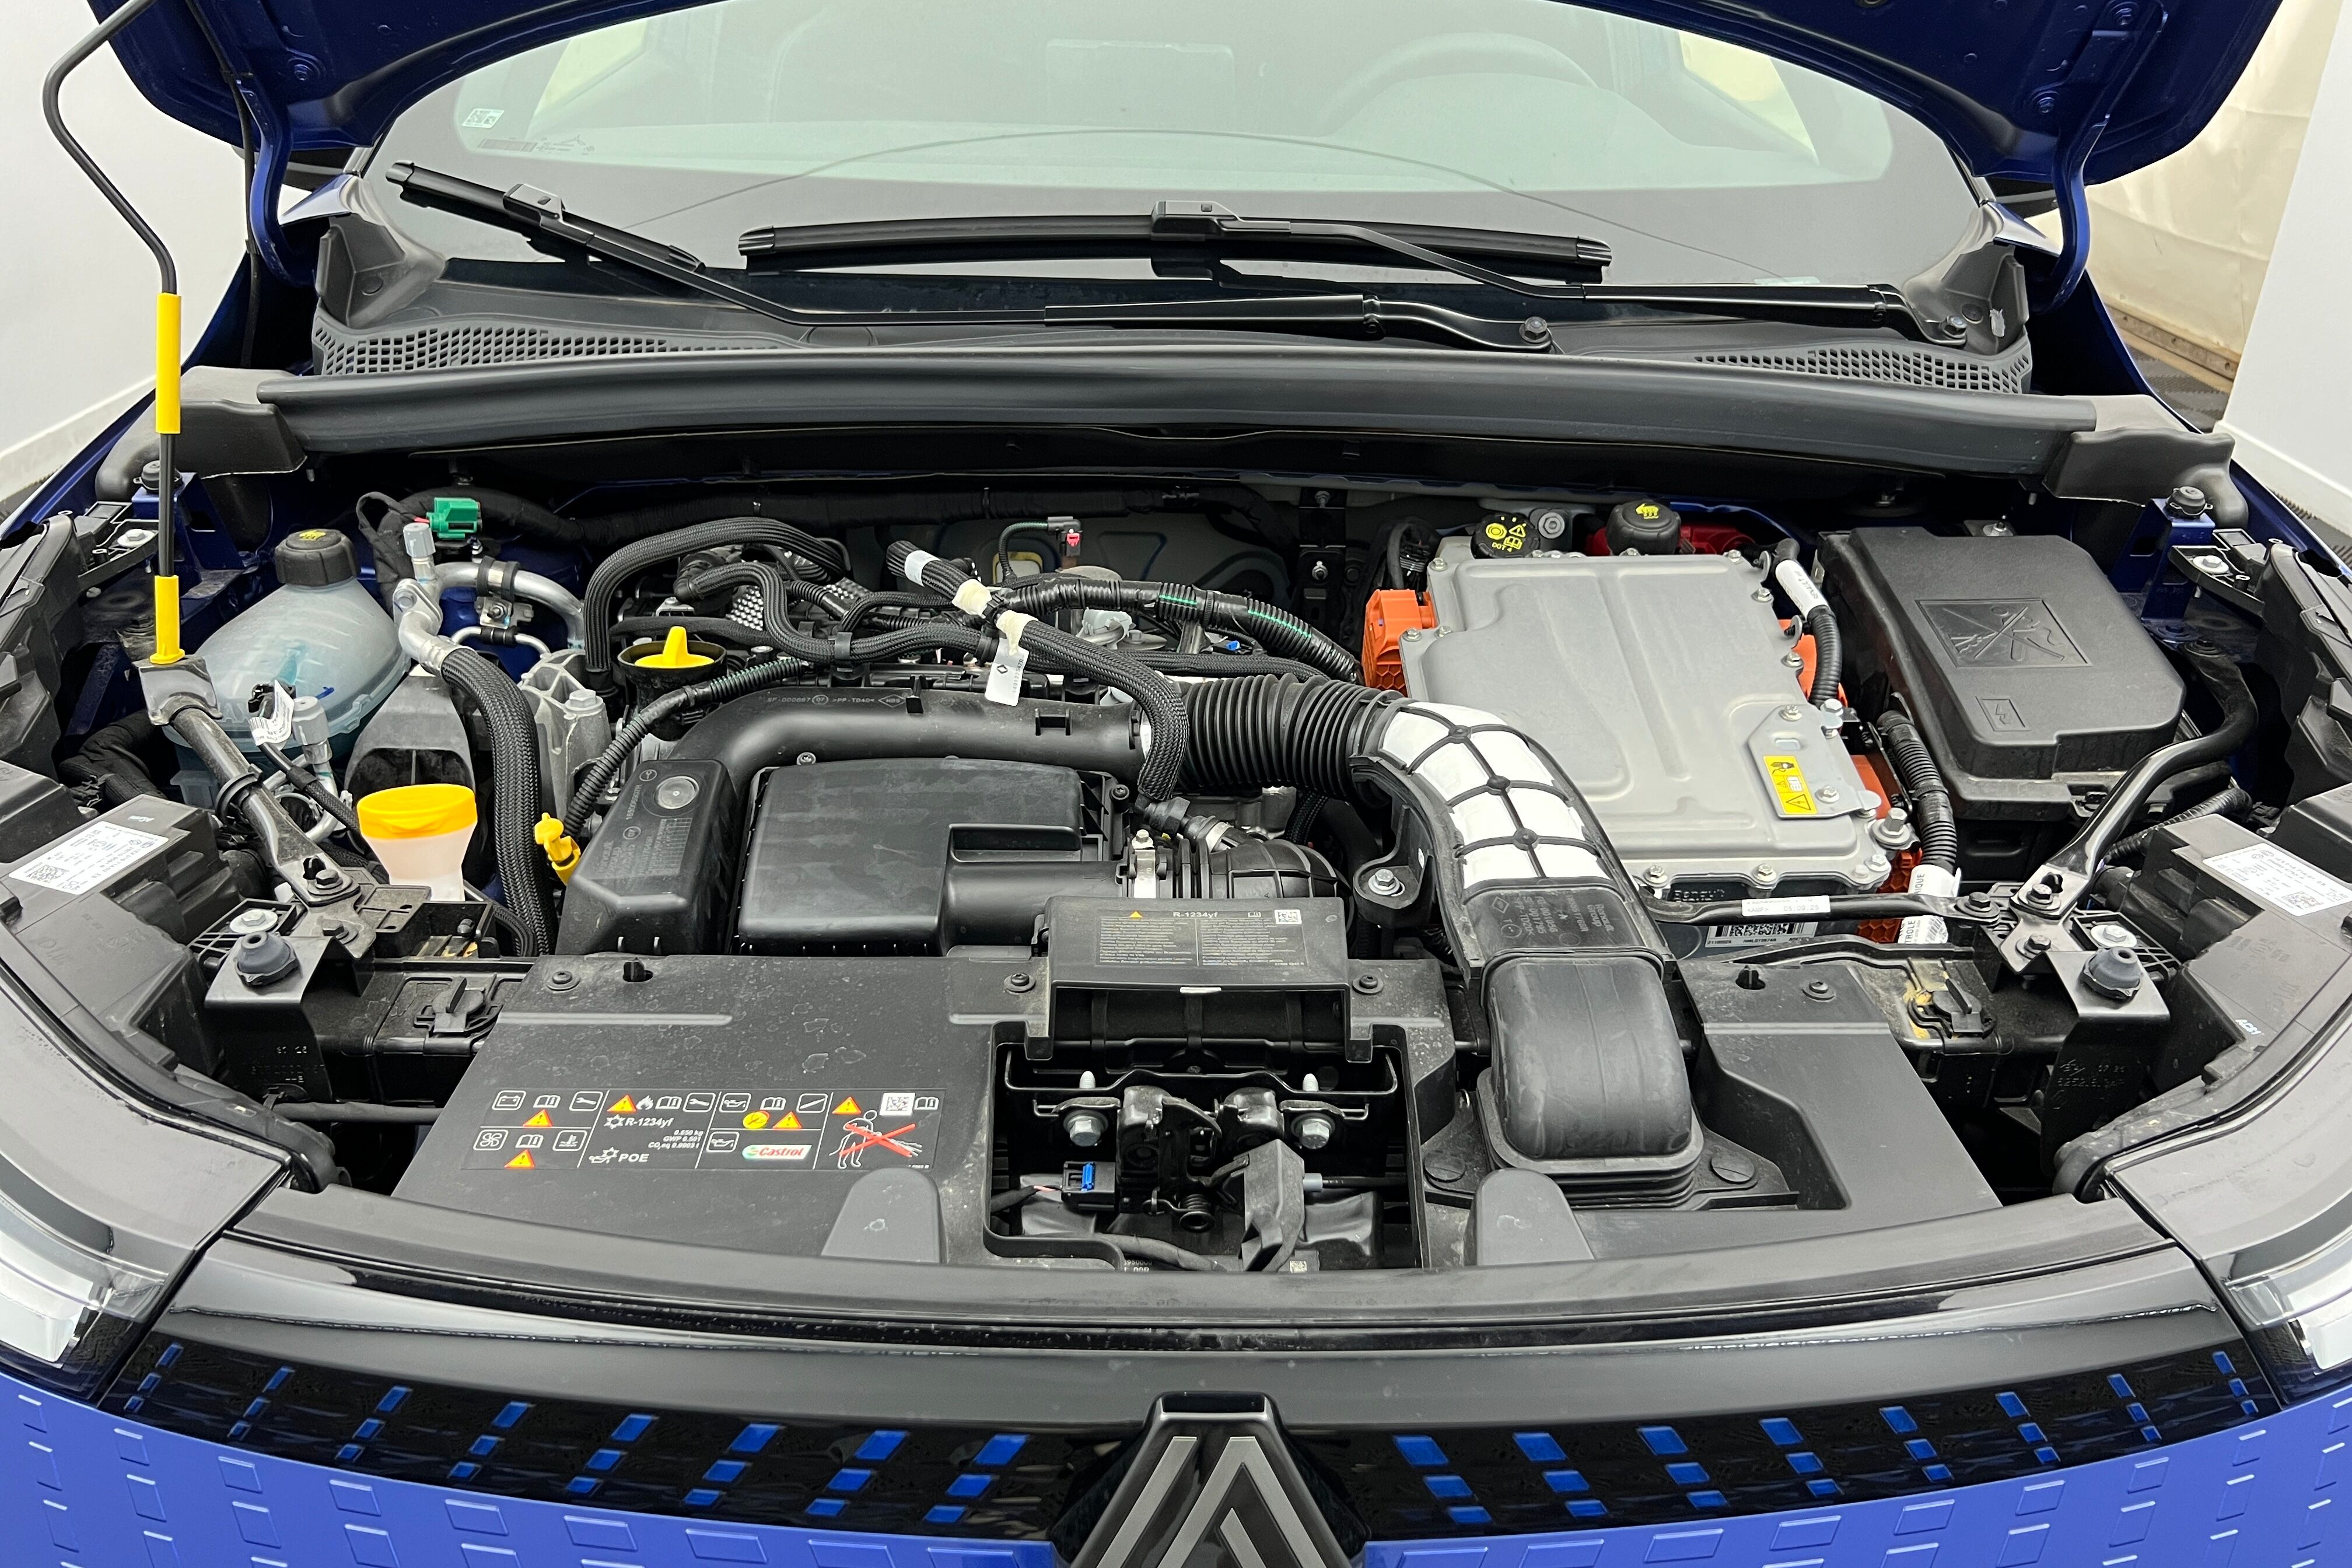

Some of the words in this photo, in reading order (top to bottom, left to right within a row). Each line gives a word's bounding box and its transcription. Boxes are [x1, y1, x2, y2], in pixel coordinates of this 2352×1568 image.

[1492, 542, 1506, 550] DOT
[1587, 904, 1602, 927] Group
[1595, 904, 1615, 932] Renault
[625, 1117, 674, 1128] R-1234yf
[759, 1147, 804, 1156] Castrol
[618, 1153, 650, 1162] POE
